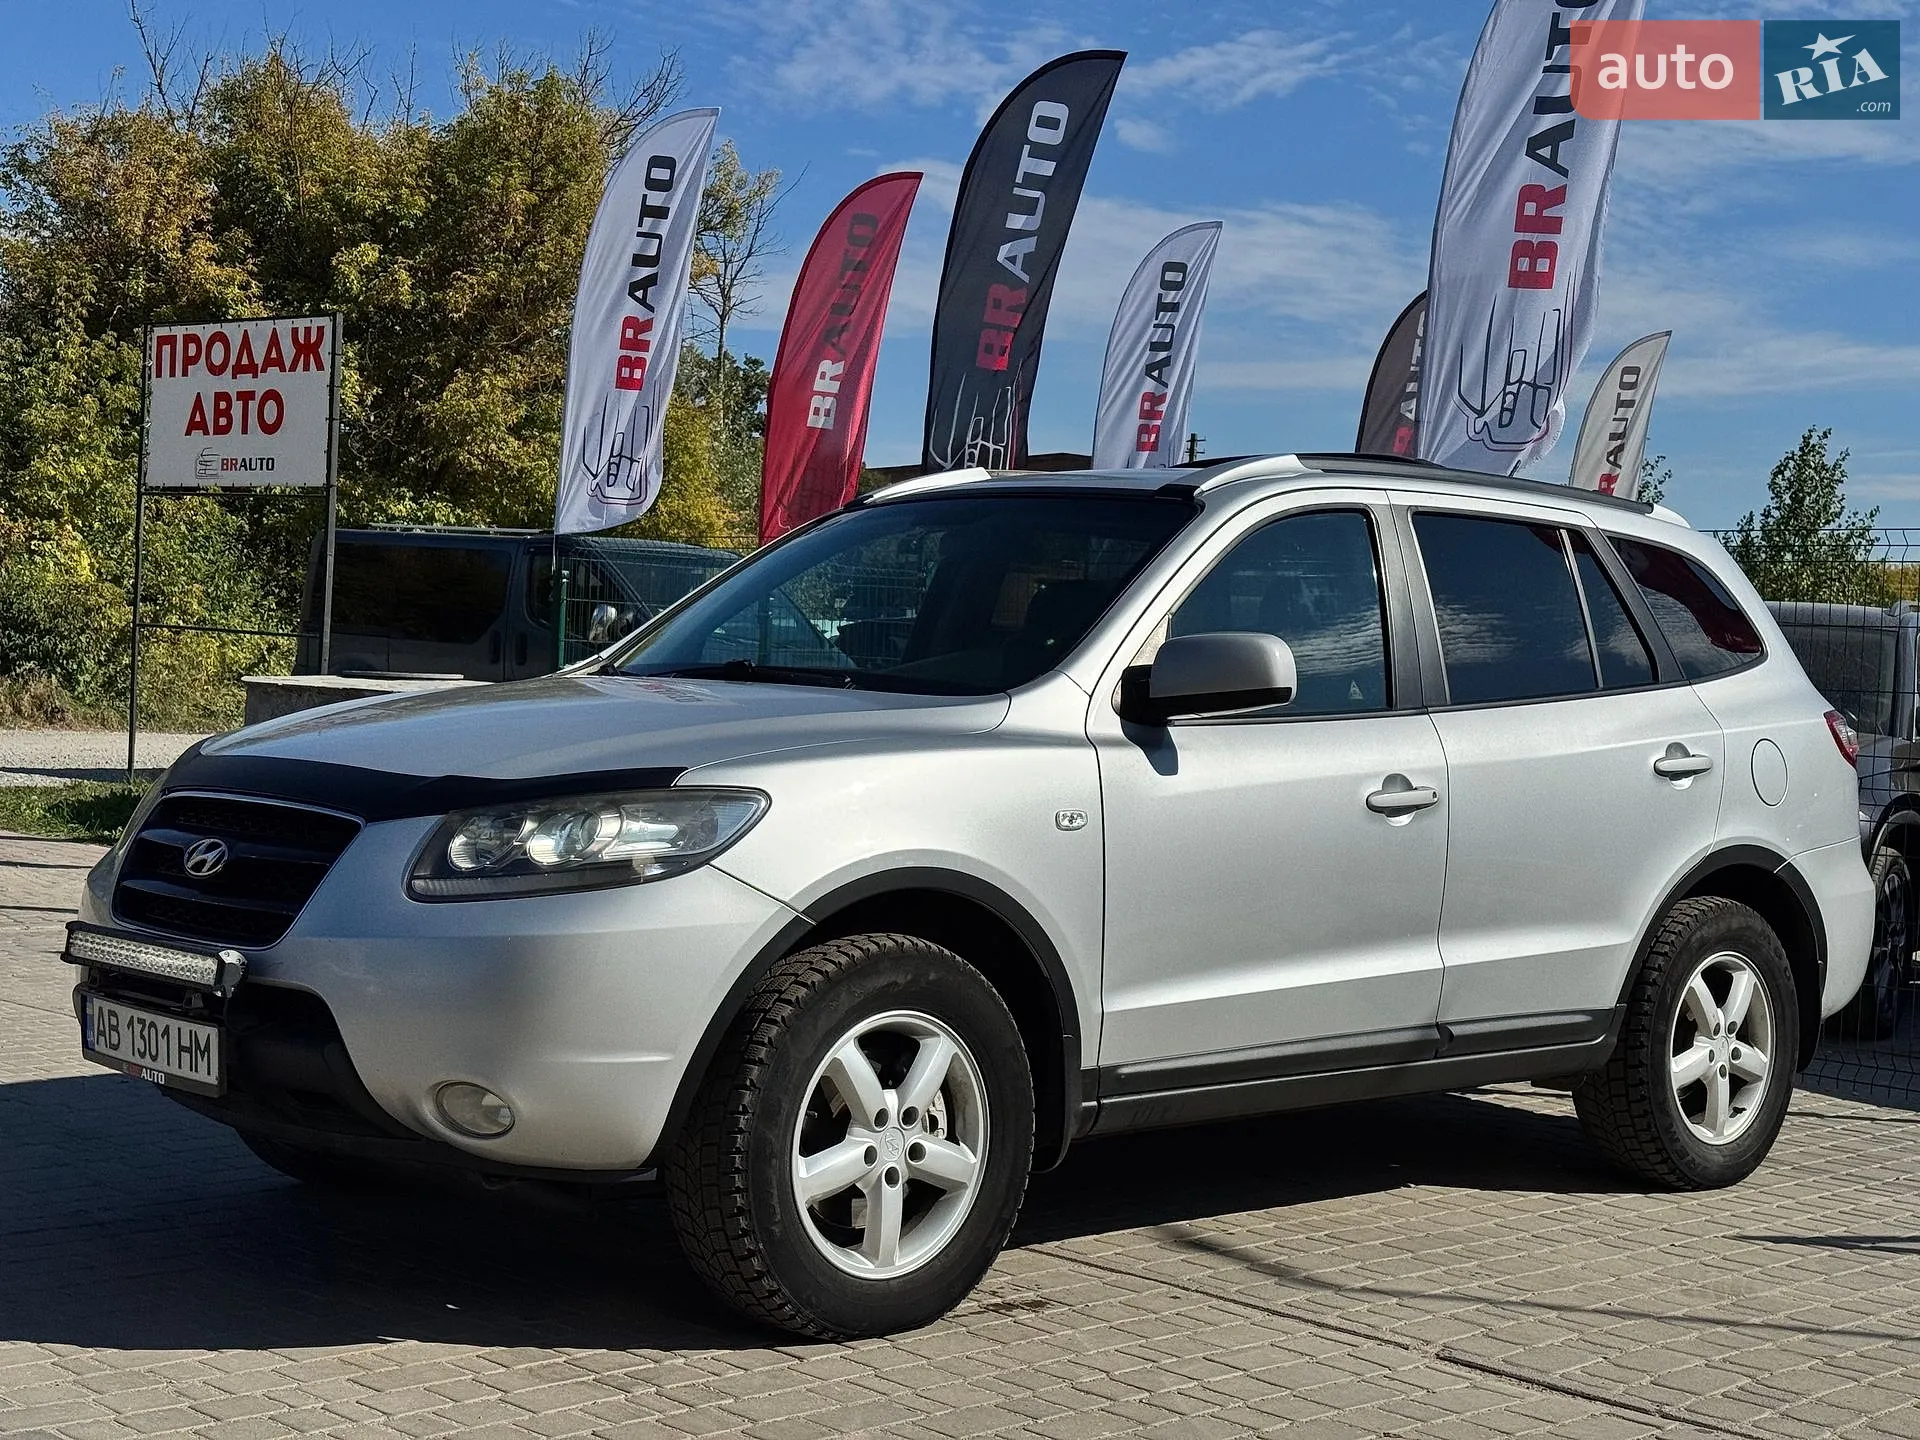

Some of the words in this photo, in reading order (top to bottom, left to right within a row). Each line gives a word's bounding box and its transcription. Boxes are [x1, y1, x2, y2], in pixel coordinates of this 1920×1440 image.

[975, 100, 1070, 371] BRAUTO
[1507, 0, 1597, 289] BRAUT
[155, 325, 325, 380] ПРОДАЖ
[615, 154, 677, 391] BRAUTO
[806, 212, 880, 430] BRAUTO
[1136, 261, 1189, 452] BRAUTO
[184, 388, 285, 437] АВТО
[220, 457, 275, 472] BRAUTO
[96, 1006, 120, 1051] AB
[127, 1014, 171, 1067] 1301
[177, 1027, 211, 1076] HM
